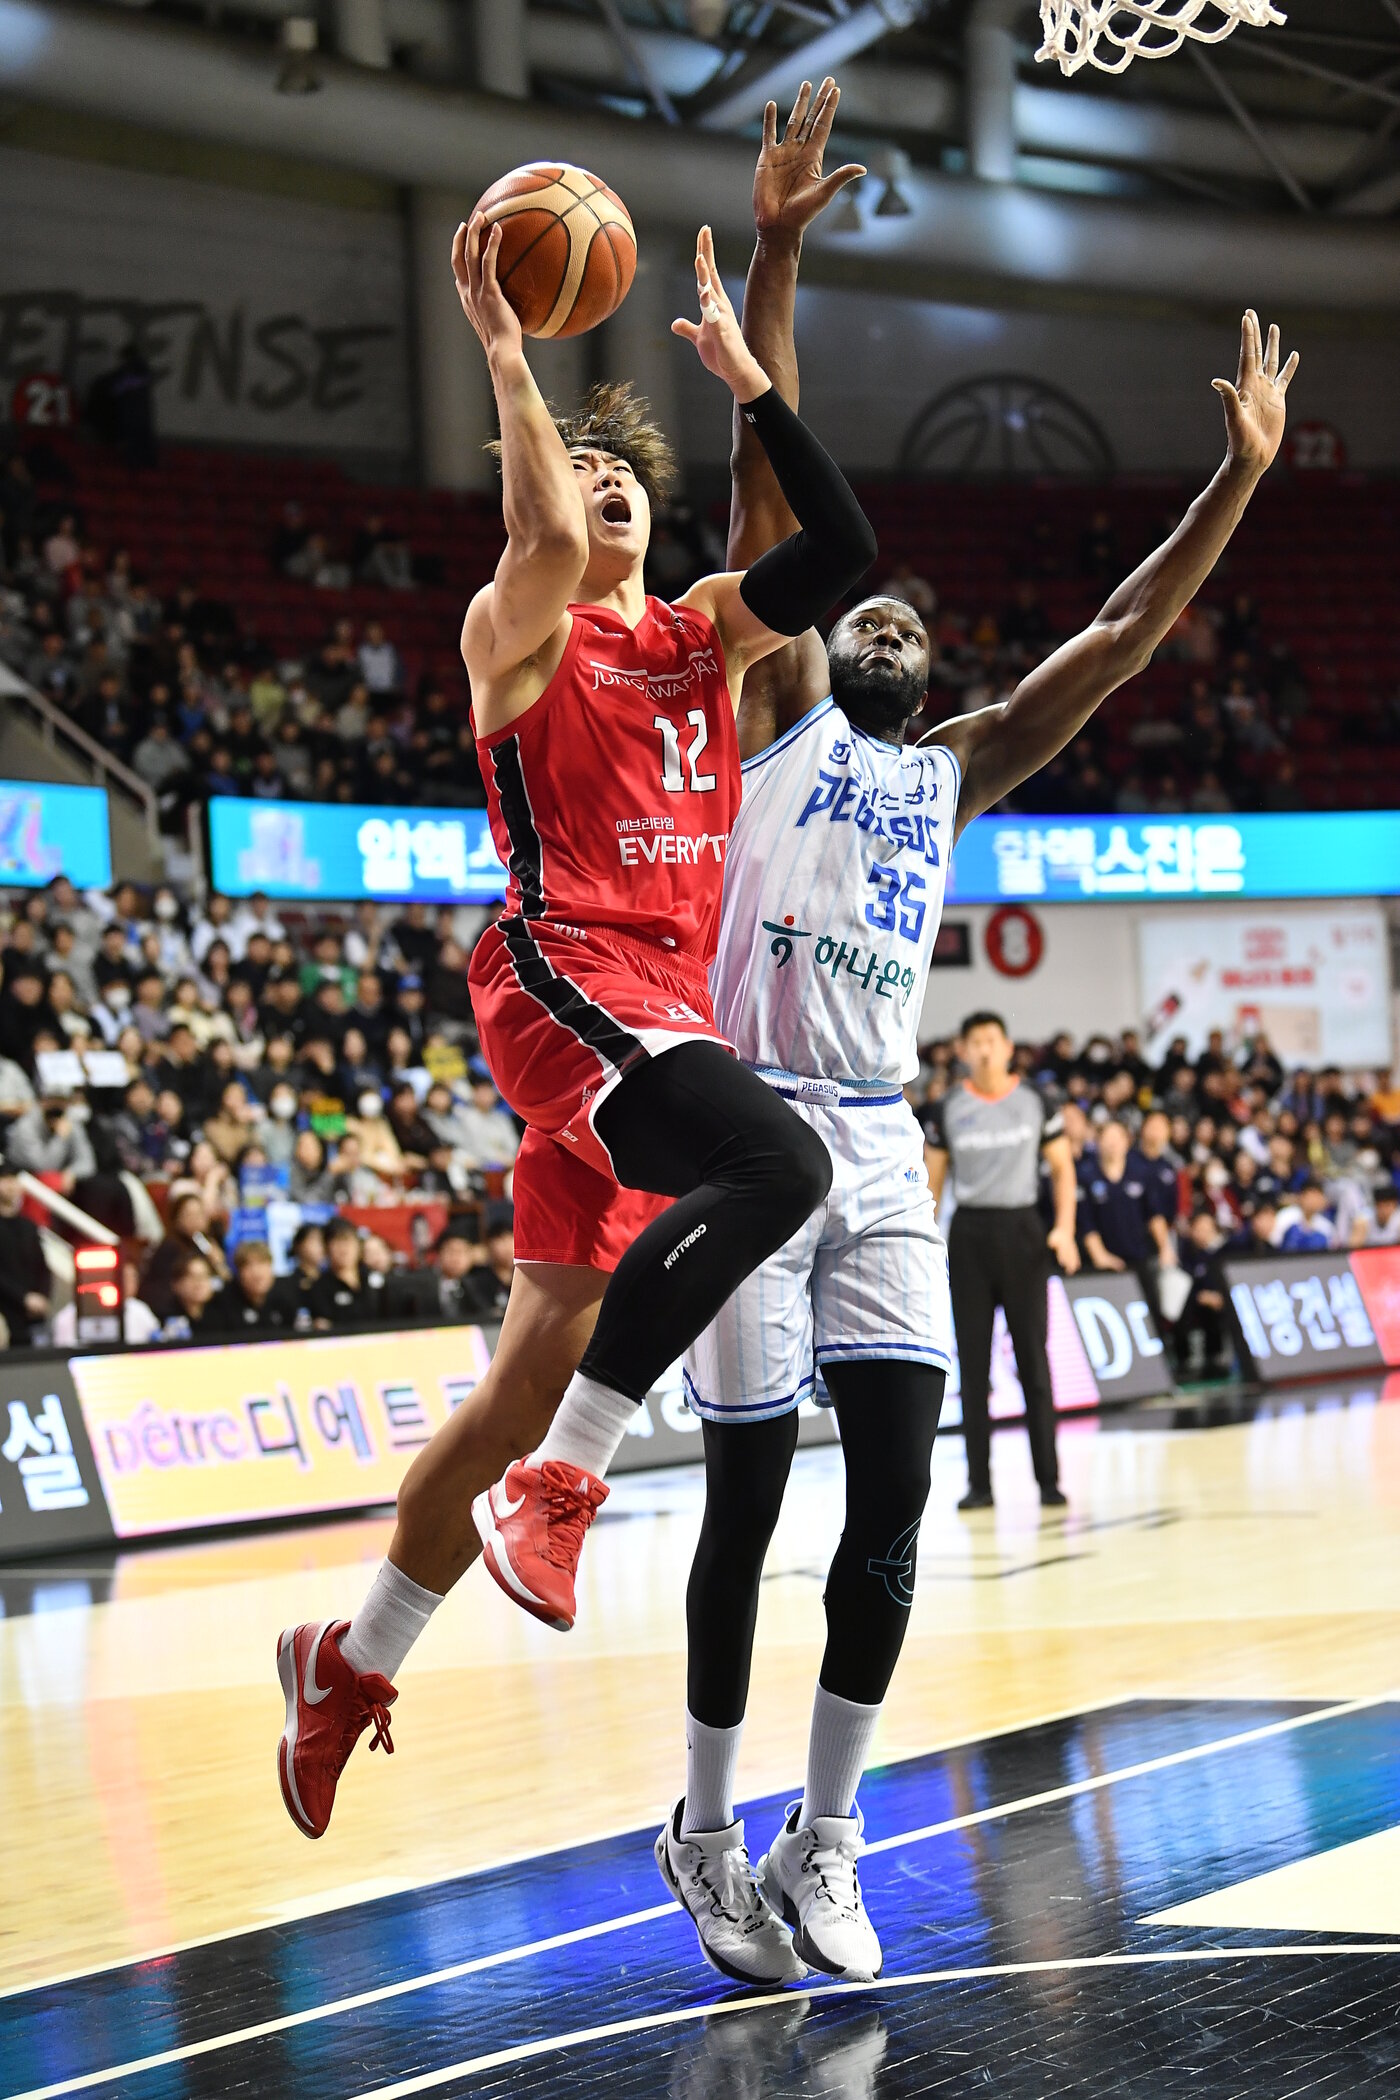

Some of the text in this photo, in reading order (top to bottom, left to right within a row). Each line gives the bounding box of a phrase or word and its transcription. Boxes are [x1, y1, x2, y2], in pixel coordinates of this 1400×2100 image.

[24, 379, 72, 425] 21
[653, 708, 717, 792] 12
[615, 816, 675, 833] 에브리타임
[865, 862, 926, 943] 35
[814, 935, 917, 1008] 하나은행
[801, 1080, 839, 1098] PEGASUS
[663, 1223, 707, 1270] CORALIAN
